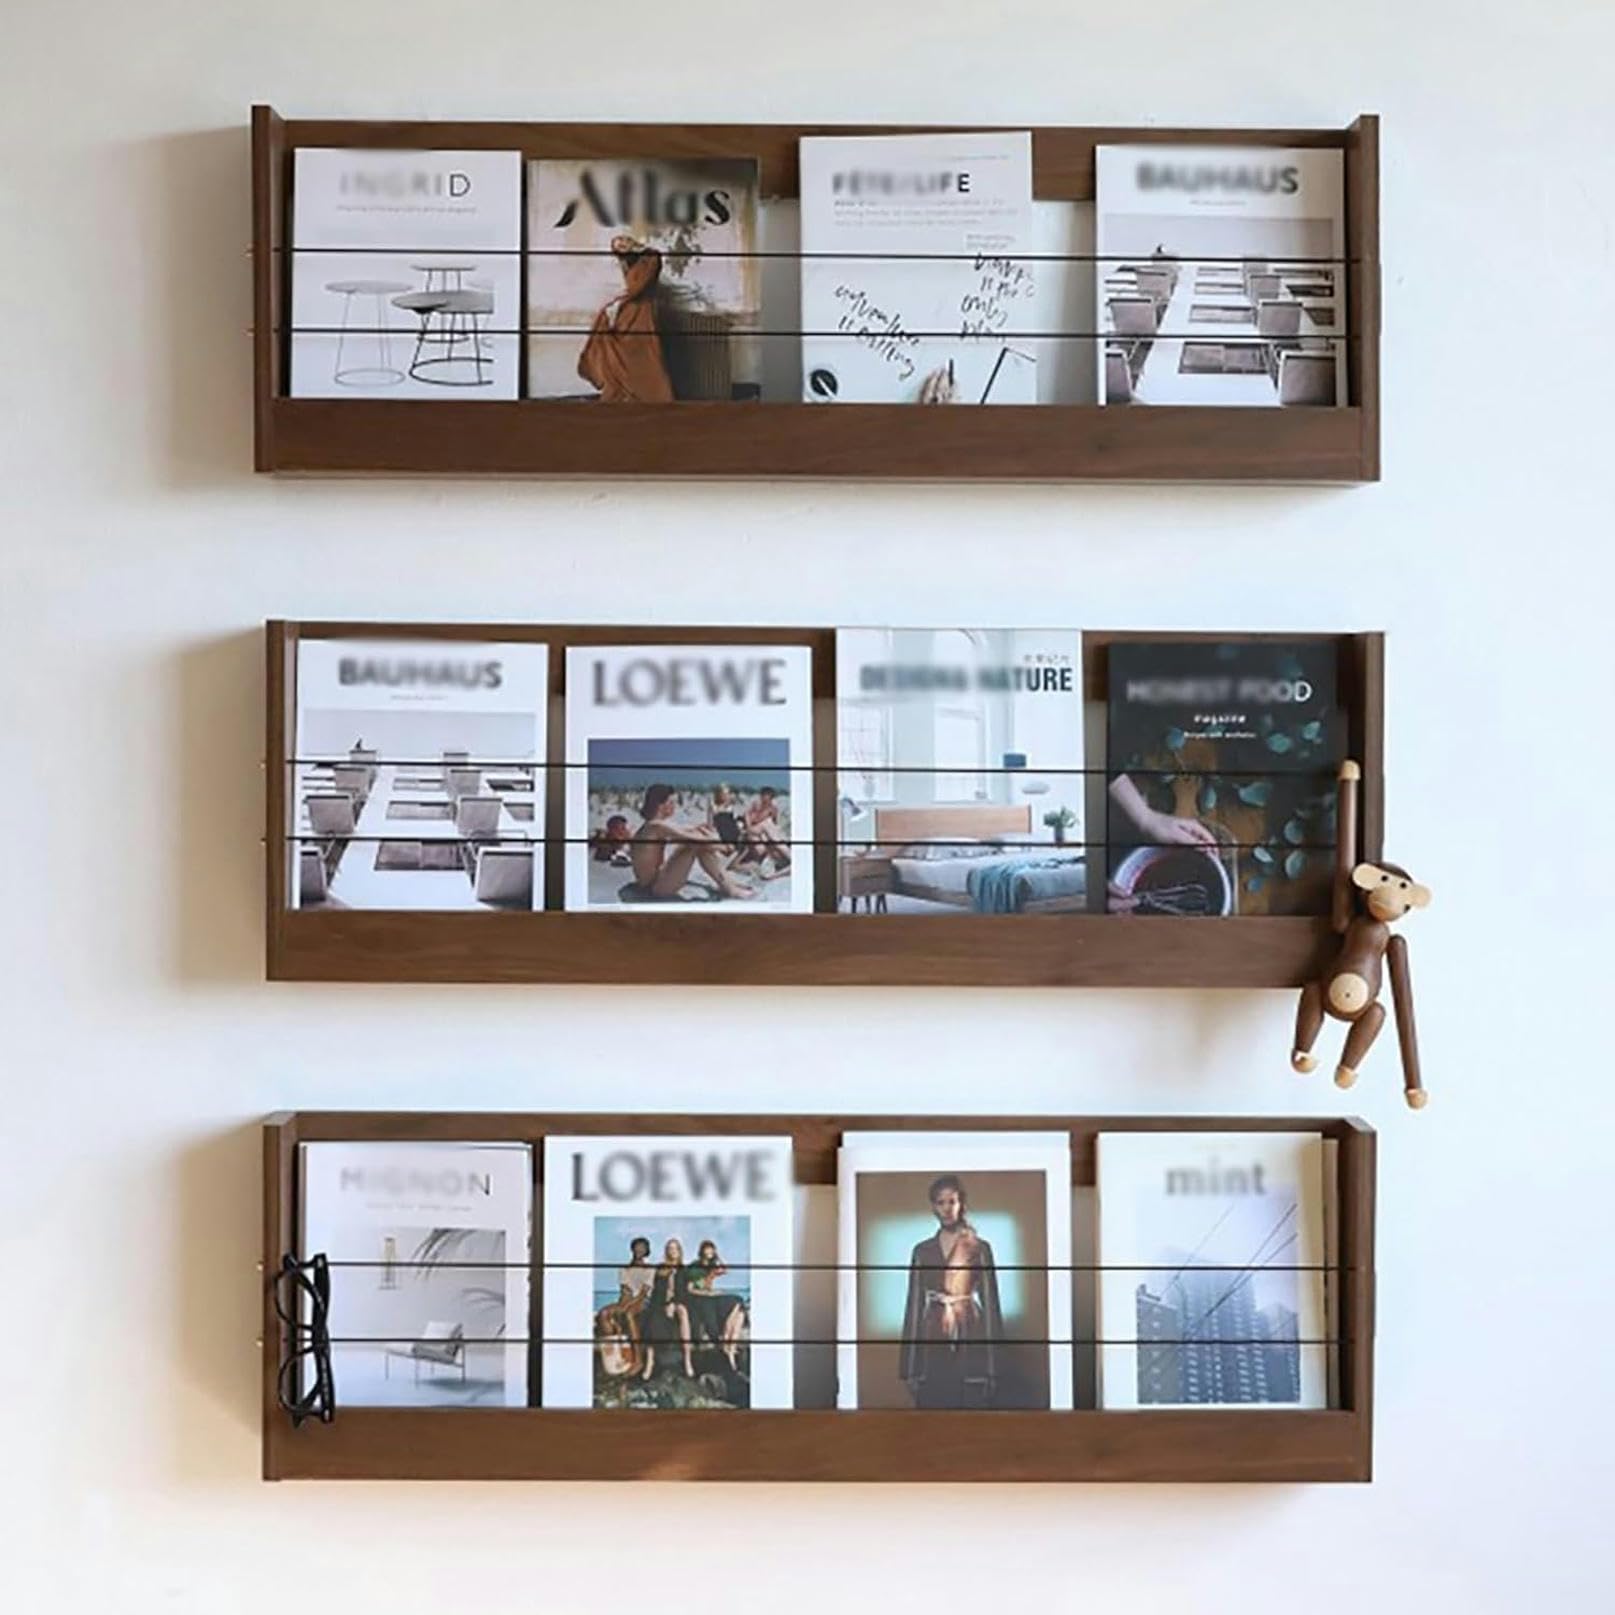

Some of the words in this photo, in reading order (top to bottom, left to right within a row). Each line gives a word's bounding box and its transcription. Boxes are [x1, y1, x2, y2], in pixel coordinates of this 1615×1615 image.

[554, 170, 730, 227] Atlas
[1137, 160, 1298, 195] BAUHAUS
[339, 657, 502, 690] BAUHAUS
[593, 659, 787, 706] LOEWE
[571, 1149, 775, 1202] LOEWE
[1166, 1156, 1265, 1195] mint
